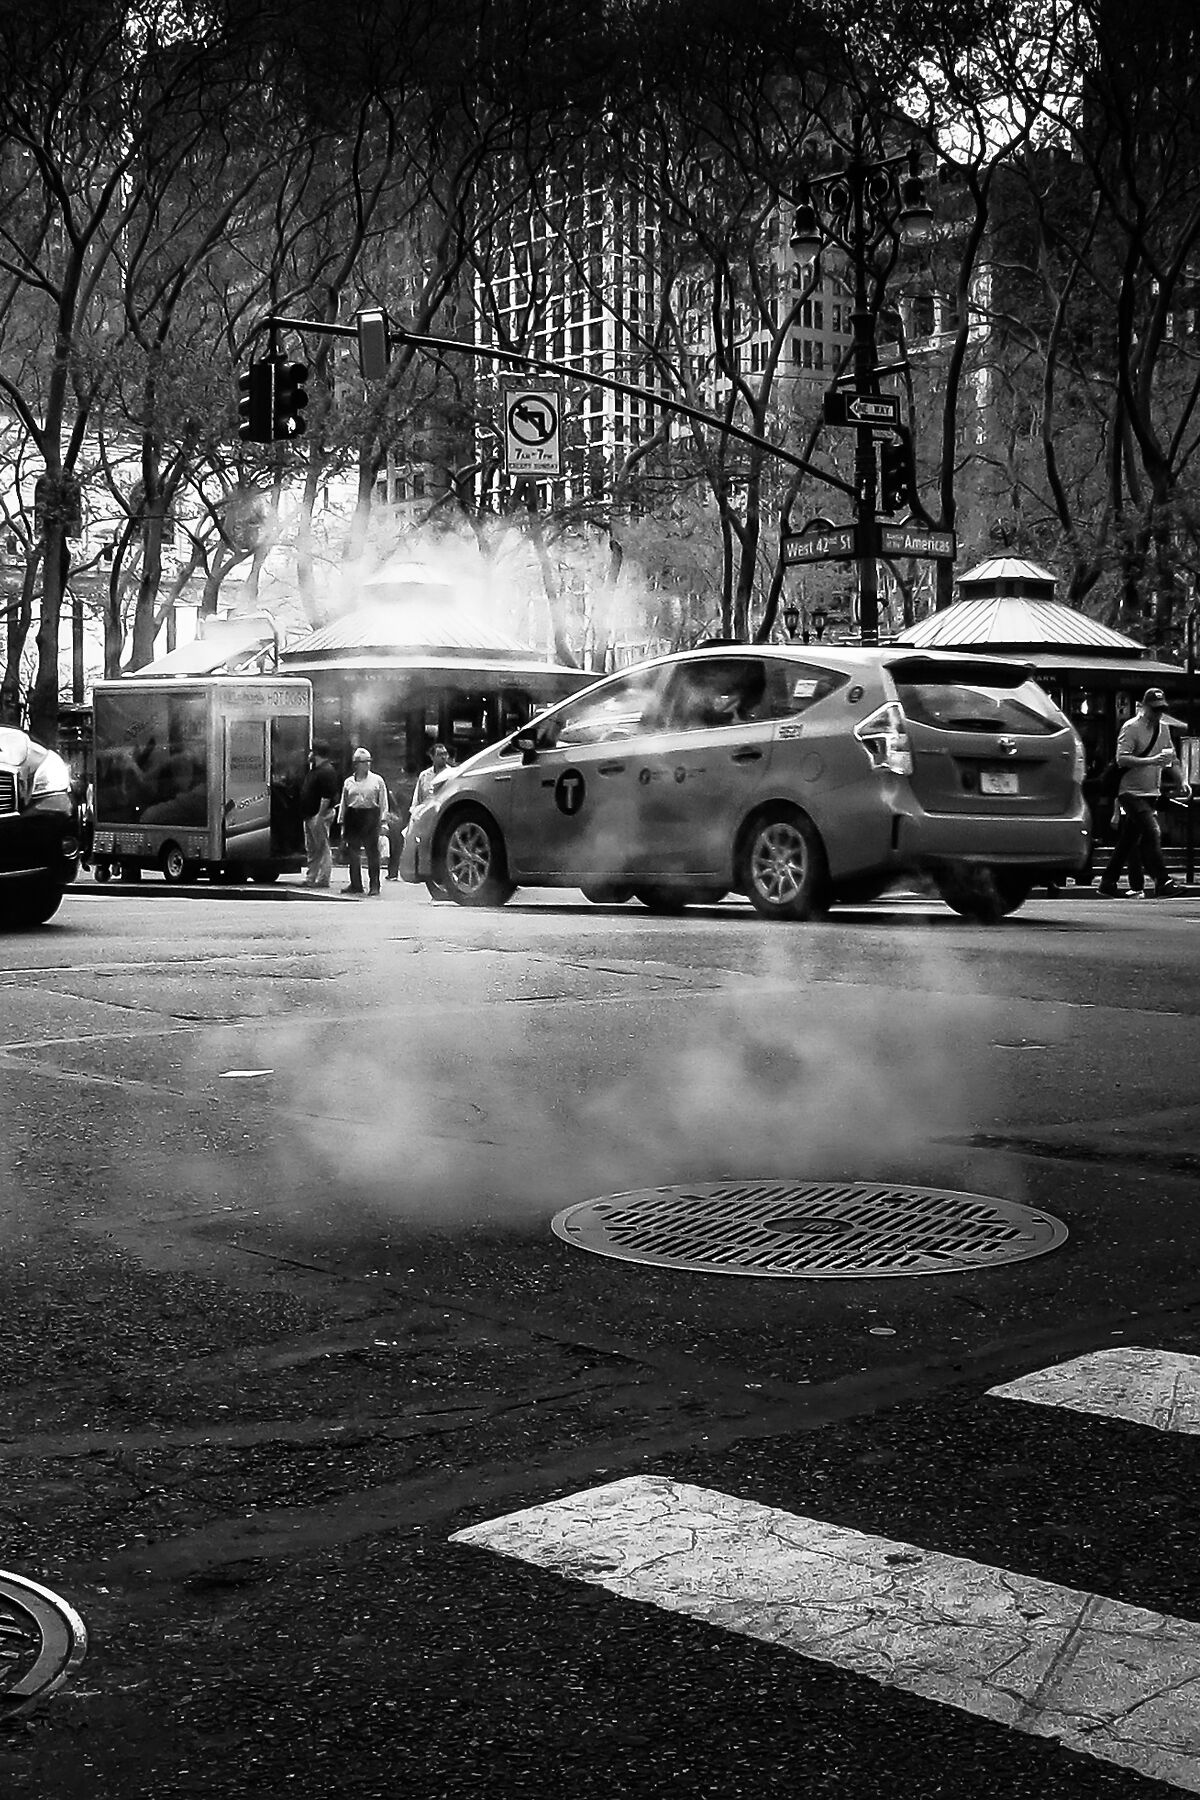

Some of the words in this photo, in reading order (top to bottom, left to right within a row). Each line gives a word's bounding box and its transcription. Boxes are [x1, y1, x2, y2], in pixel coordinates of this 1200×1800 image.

[873, 405, 892, 414] WAY
[787, 541, 813, 558] West
[840, 534, 851, 550] St
[904, 535, 950, 553] Americas
[563, 778, 579, 809] T
